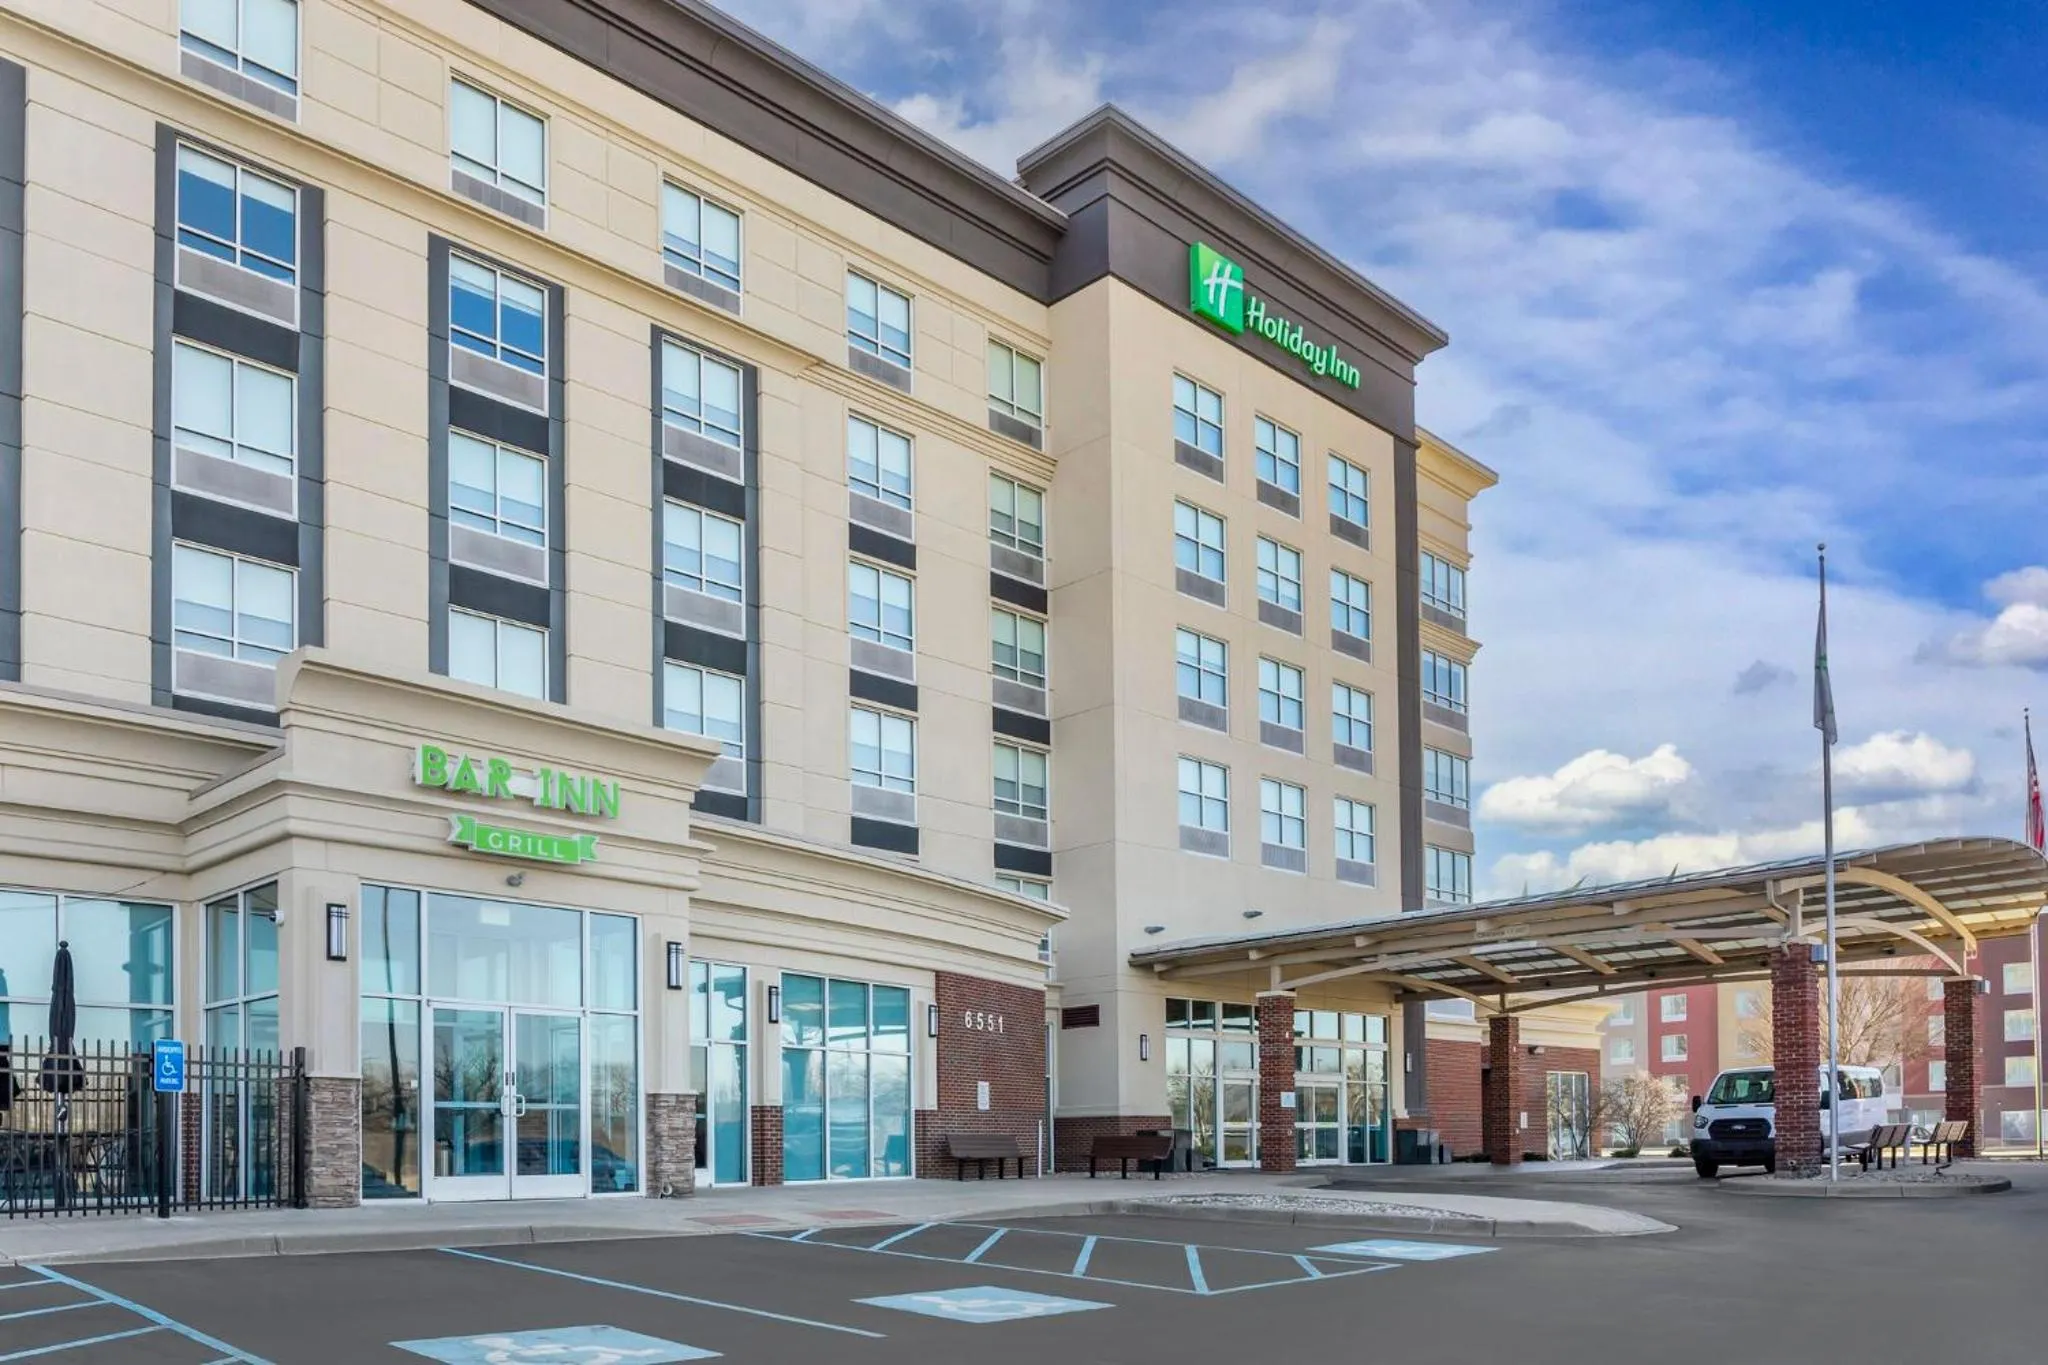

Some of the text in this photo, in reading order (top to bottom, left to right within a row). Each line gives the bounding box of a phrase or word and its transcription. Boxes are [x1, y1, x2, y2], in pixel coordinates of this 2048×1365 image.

[1246, 296, 1360, 389] Holiday Inn
[417, 744, 619, 818] BAR INN
[488, 832, 565, 858] GRILL
[964, 1010, 1003, 1033] 6551
